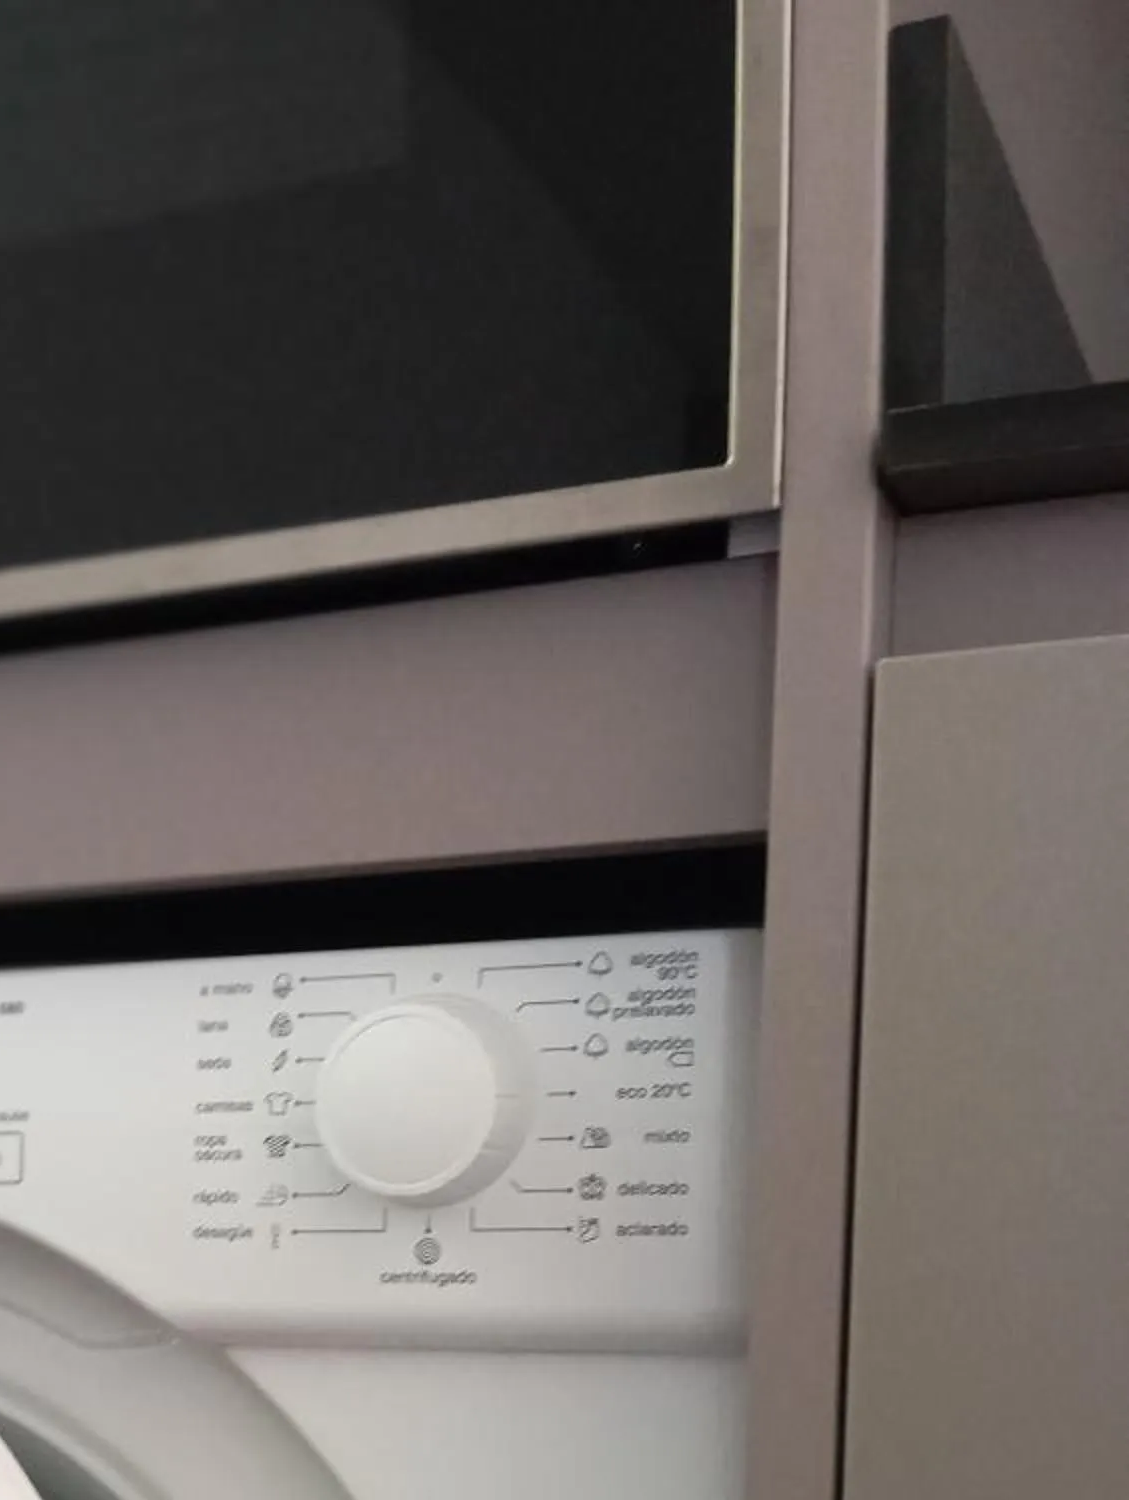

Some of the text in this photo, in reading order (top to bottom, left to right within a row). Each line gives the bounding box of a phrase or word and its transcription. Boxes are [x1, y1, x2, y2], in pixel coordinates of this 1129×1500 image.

[615, 1087, 648, 1100] eco
[616, 1180, 690, 1197] delicado
[379, 1269, 478, 1287] centrifugado
